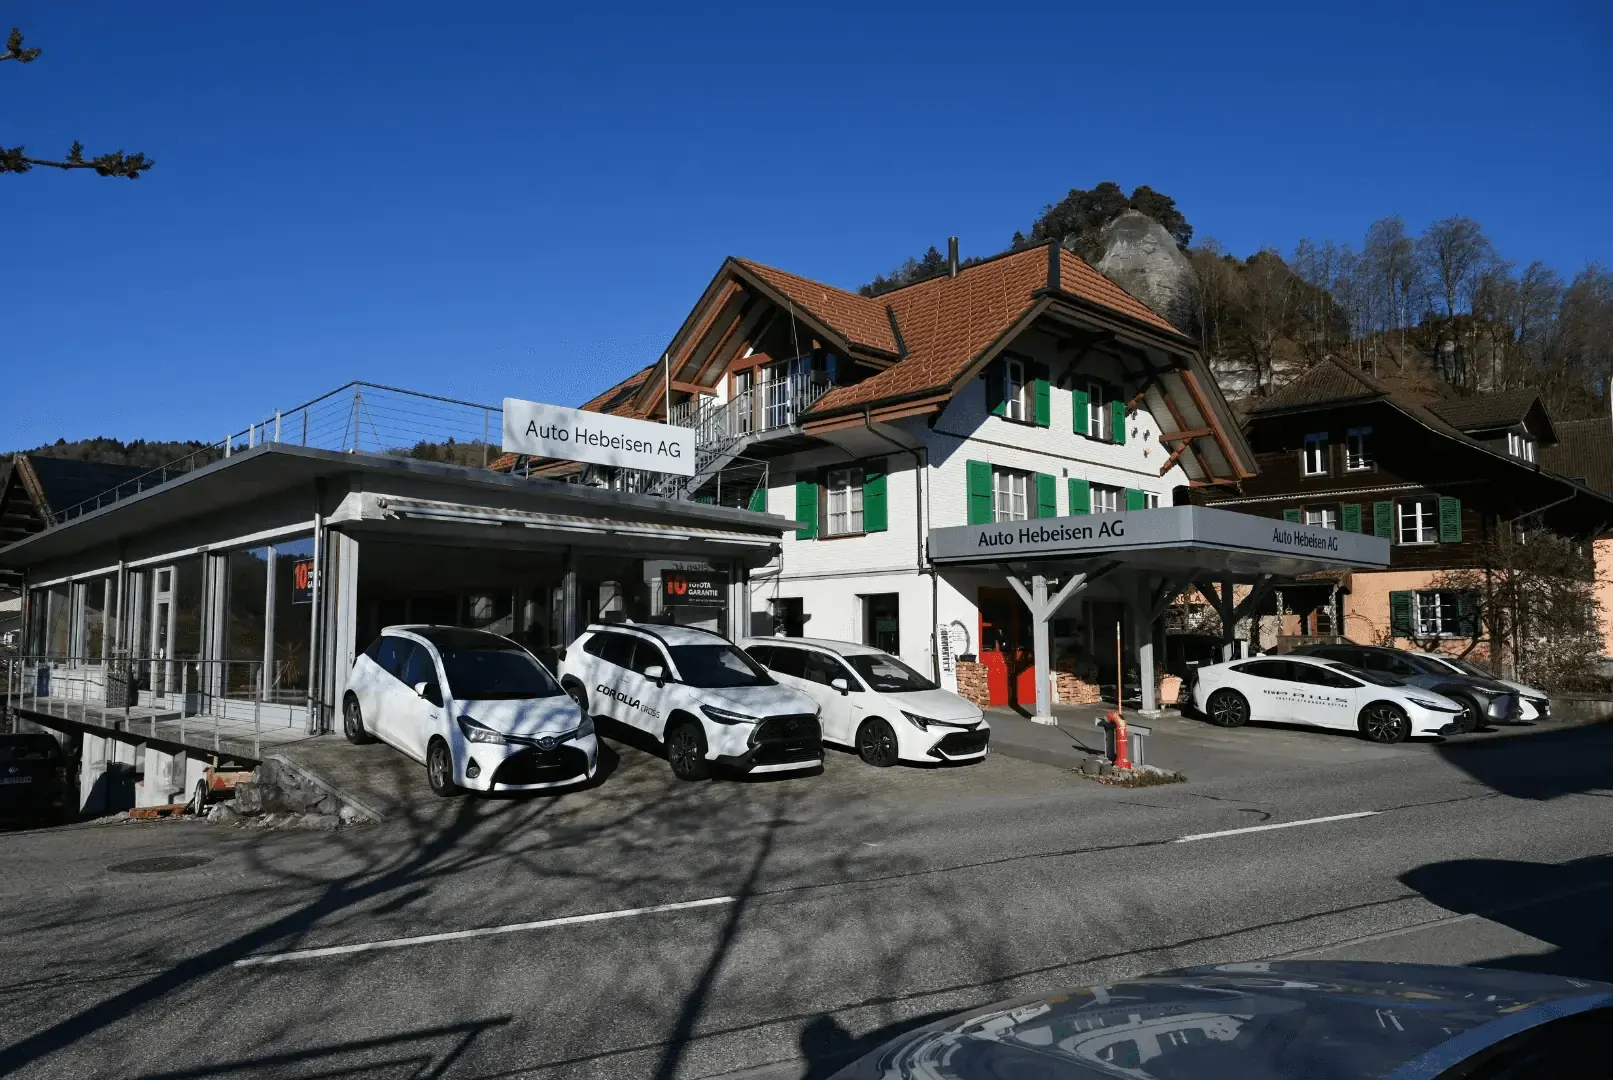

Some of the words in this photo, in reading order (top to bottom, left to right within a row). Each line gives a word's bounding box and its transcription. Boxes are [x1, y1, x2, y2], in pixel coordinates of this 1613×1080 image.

[525, 420, 569, 442] Auto
[575, 427, 652, 454] Hebeisen
[657, 440, 681, 458] AG
[978, 531, 1014, 547] Auto
[1018, 525, 1093, 544] Hebeisen
[1098, 520, 1124, 538] AG
[1272, 527, 1292, 545] Auto
[1293, 531, 1327, 549] Hebeisen
[1327, 536, 1338, 551] AG
[295, 563, 308, 590] 10
[688, 589, 718, 597] GARANTIE
[596, 684, 641, 709] COROLLA
[640, 704, 660, 718] CROSS
